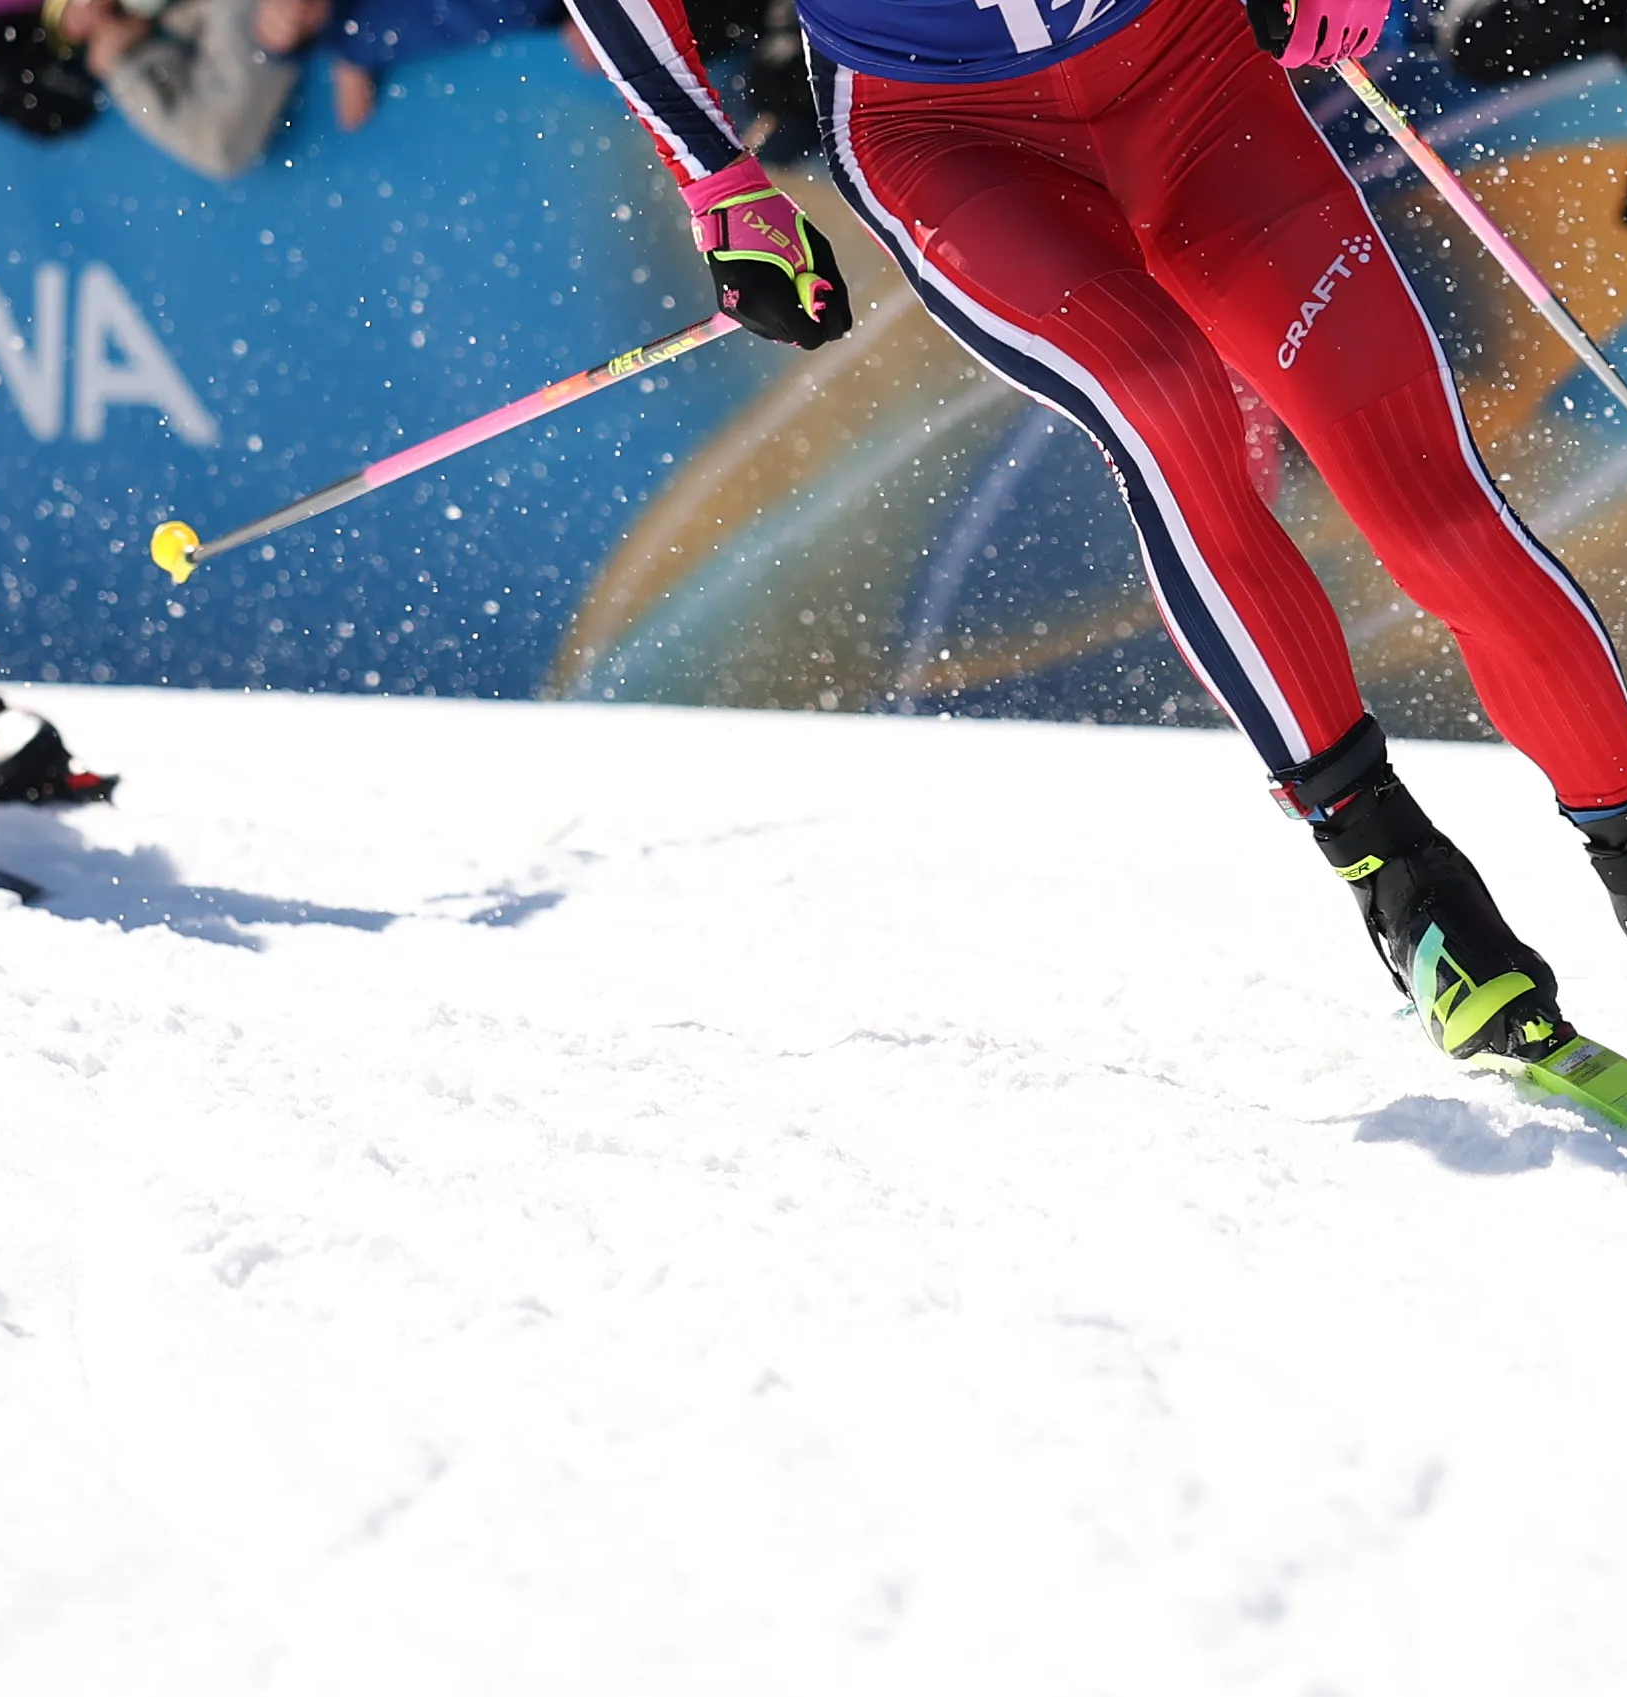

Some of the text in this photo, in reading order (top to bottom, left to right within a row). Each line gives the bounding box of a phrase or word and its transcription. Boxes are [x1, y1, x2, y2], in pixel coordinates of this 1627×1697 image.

[742, 210, 805, 270] LEKI
[1277, 253, 1352, 370] CRAFT
[1335, 861, 1371, 879] CHER
